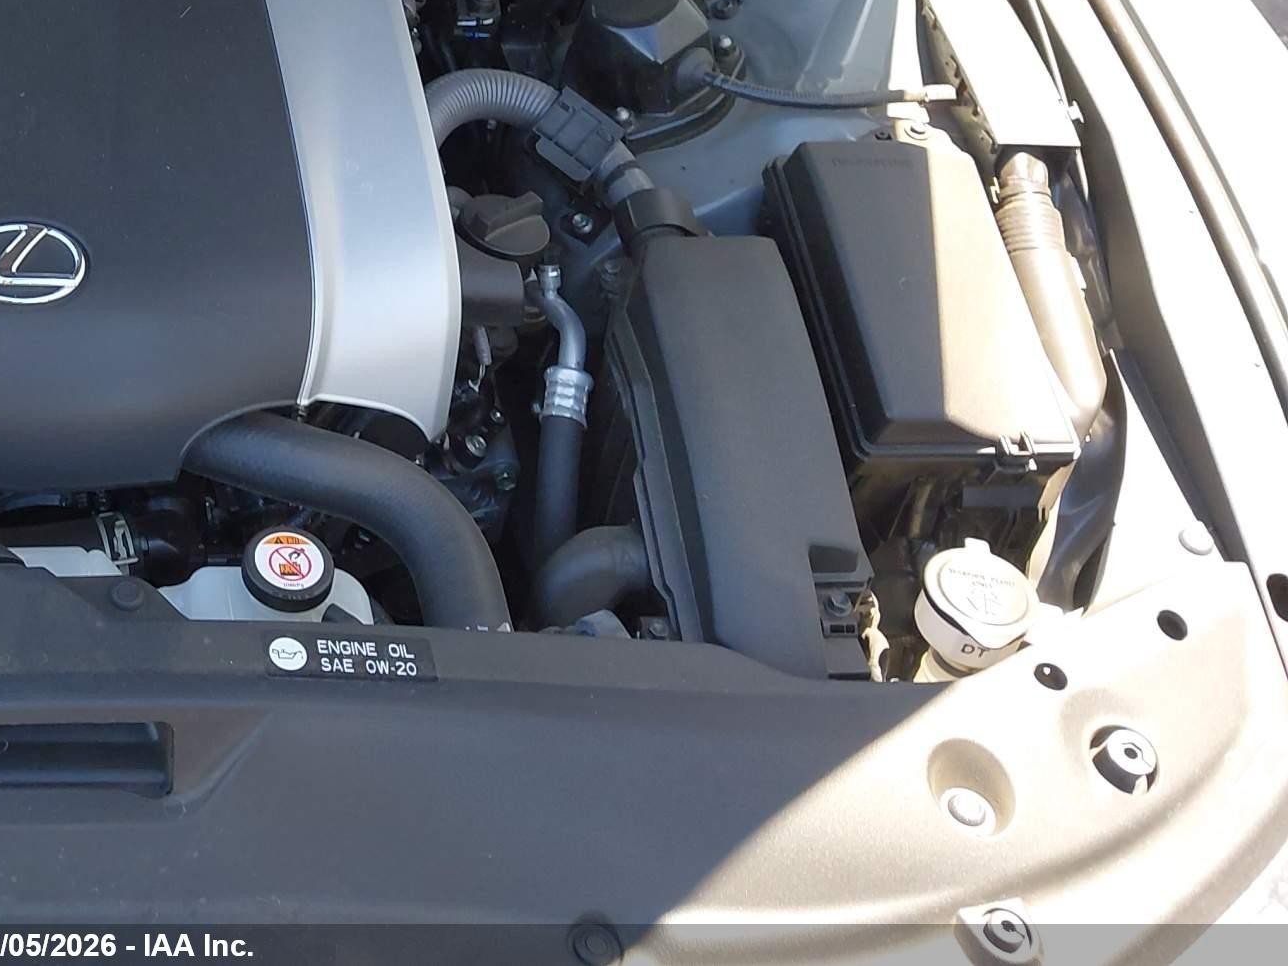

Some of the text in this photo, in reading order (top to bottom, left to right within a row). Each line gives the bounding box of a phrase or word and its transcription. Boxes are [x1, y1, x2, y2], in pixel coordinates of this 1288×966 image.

[316, 639, 415, 659] ENGINE OIL
[320, 657, 417, 676] SAE 0W-20
